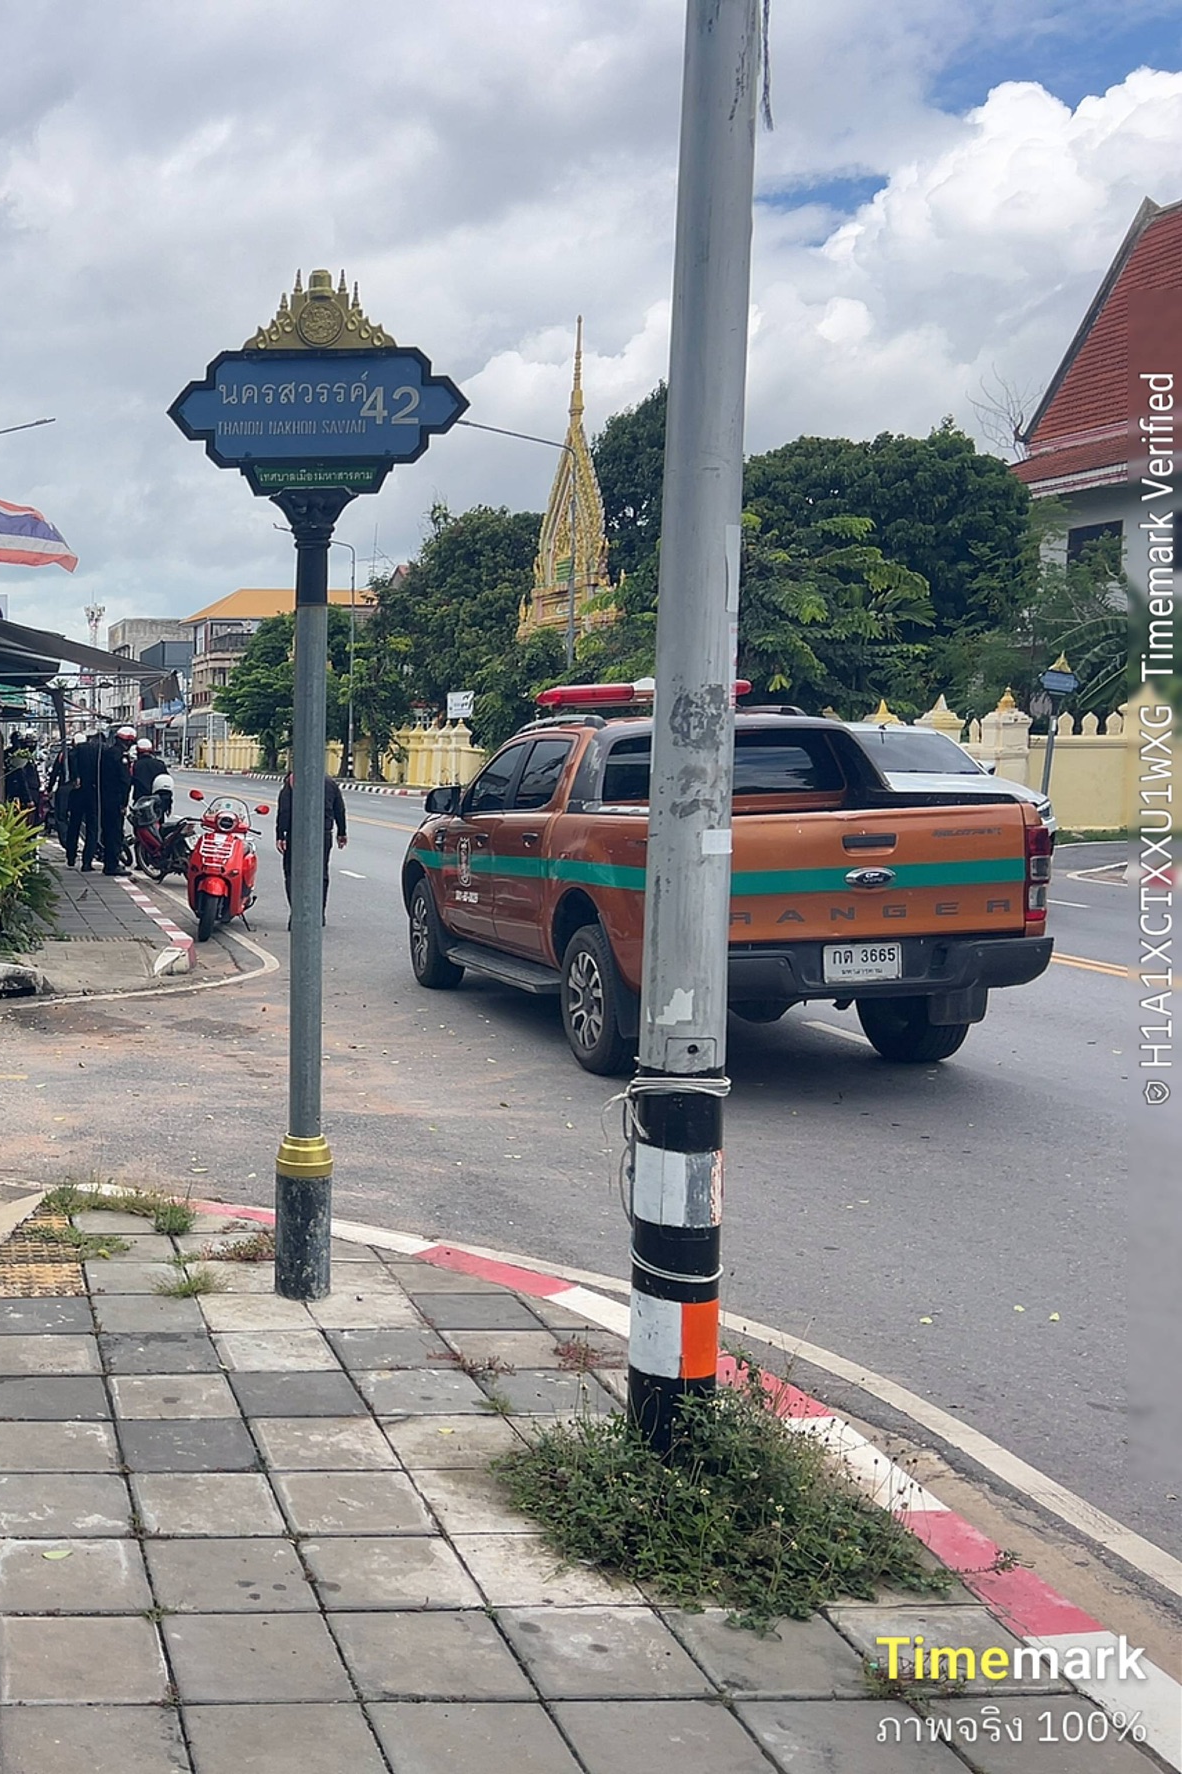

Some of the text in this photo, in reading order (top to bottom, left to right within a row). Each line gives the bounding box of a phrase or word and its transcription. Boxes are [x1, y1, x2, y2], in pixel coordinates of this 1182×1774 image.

[218, 371, 420, 425] นครสวรรค์ 42
[217, 418, 367, 436] THANON NAKHON SAWAN
[259, 469, 373, 482] เทศบาลเมืองมหาสารคาม
[729, 899, 1012, 926] RANGER
[861, 947, 896, 963] 3665
